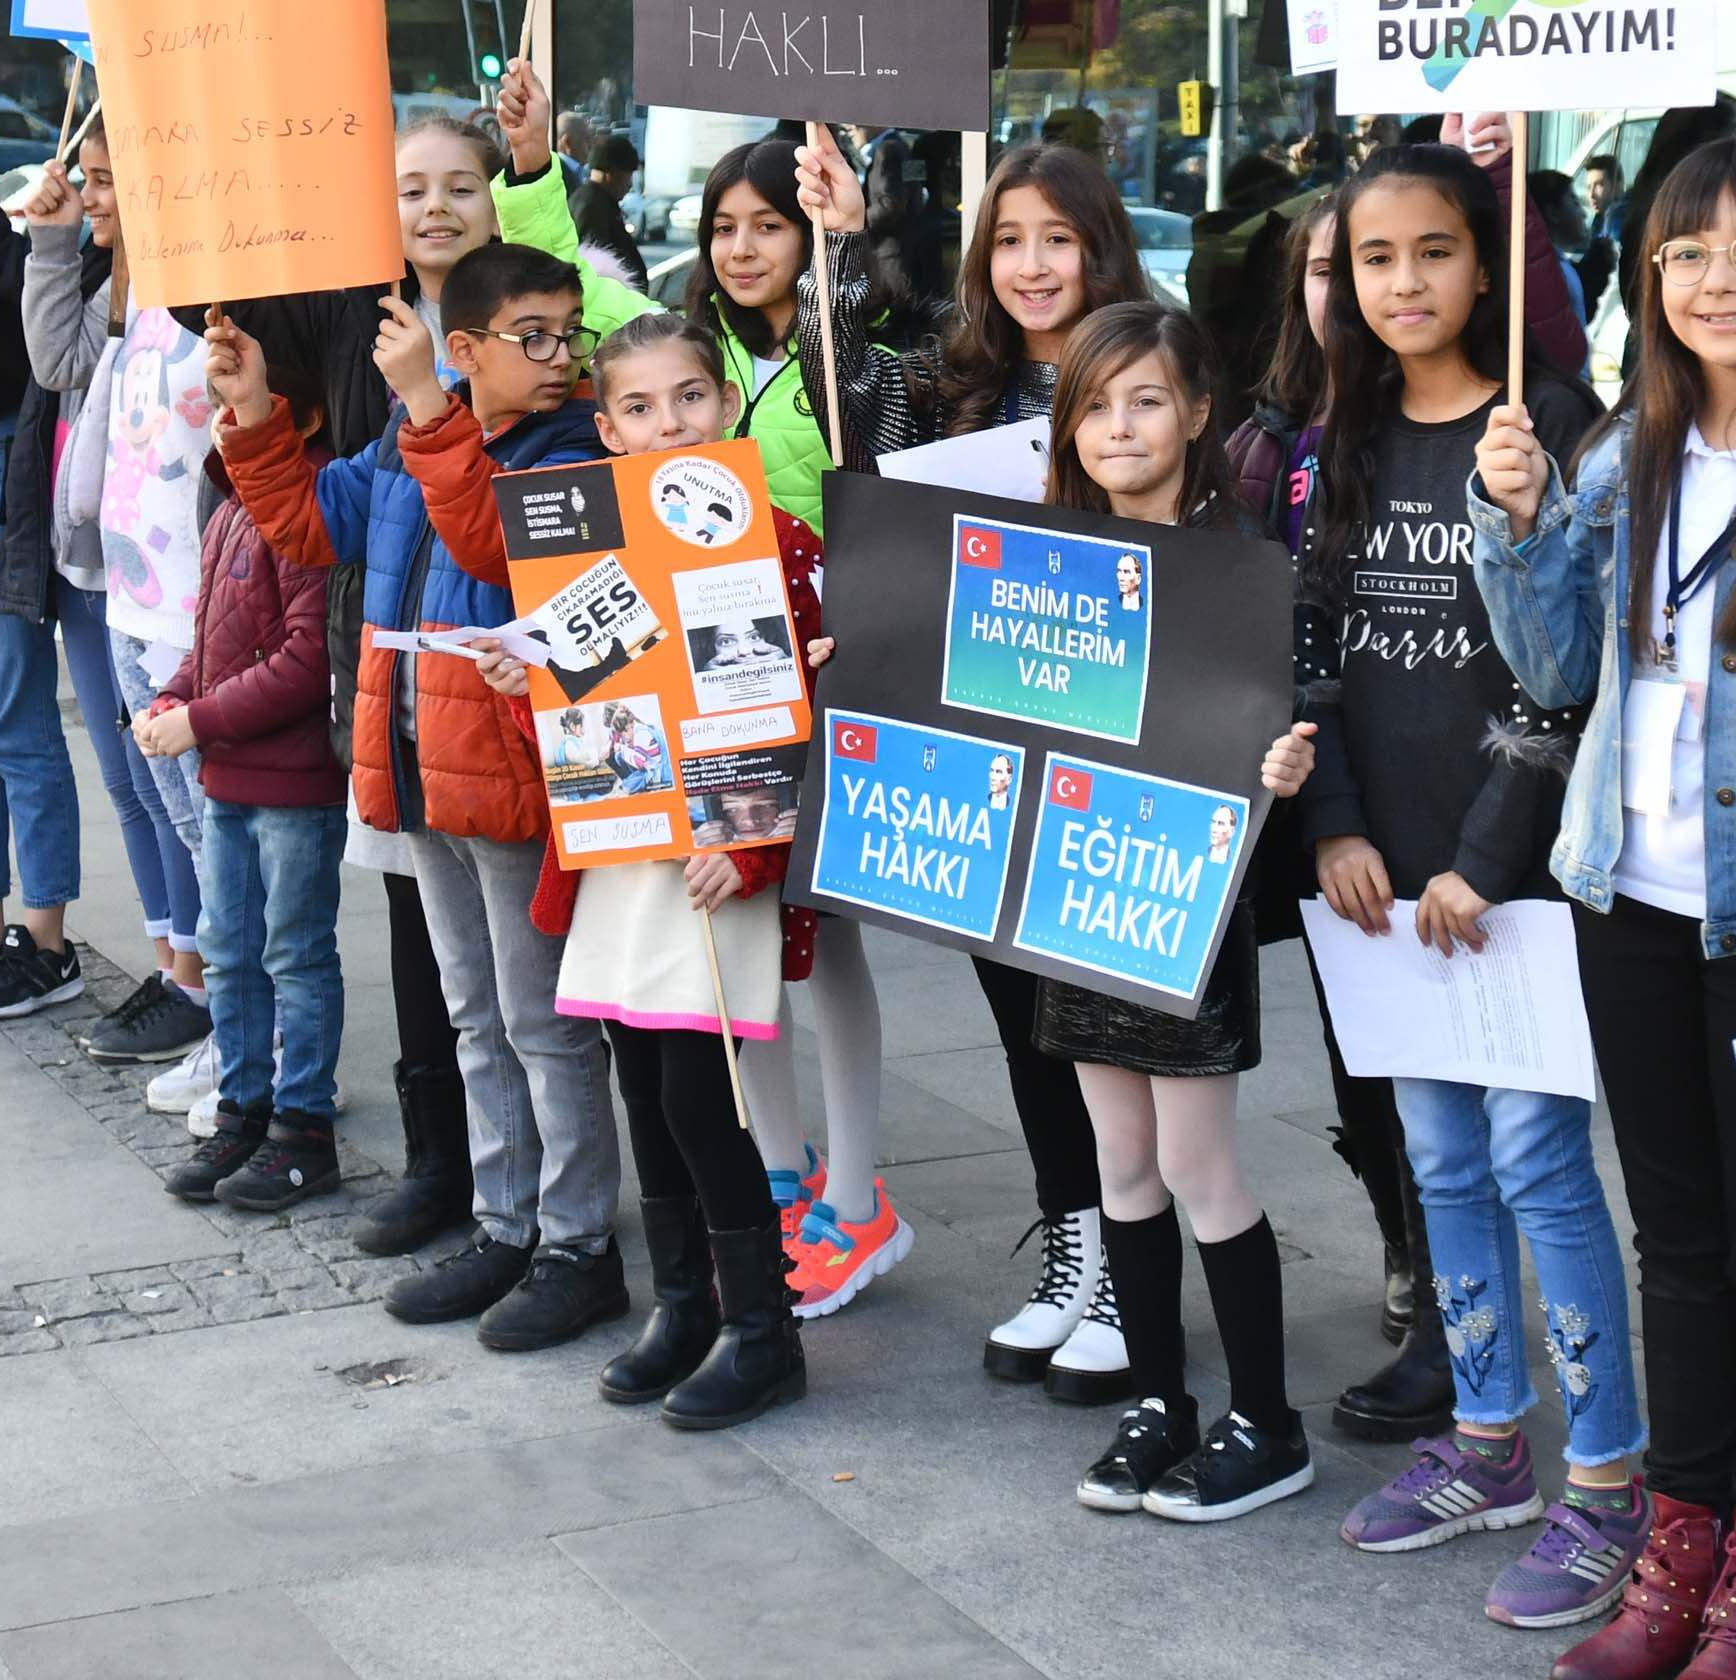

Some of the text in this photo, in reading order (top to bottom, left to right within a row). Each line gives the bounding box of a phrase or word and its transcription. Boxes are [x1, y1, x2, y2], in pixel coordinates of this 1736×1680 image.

[1377, 7, 1676, 61] BURADAYIM!
[231, 106, 365, 144] SESSİZ
[522, 491, 566, 505] ÇOCUK SUSAR
[683, 472, 733, 505] UNUTMA
[1389, 500, 1433, 514] TOKYO
[524, 506, 539, 516] SEN
[1402, 522, 1474, 565] YOR
[551, 559, 617, 612] BİR ÇOCUĞUN
[557, 568, 624, 622] ÇIKARAMADIĞI
[991, 578, 1109, 628] BENİM DE
[1361, 577, 1451, 594] STOCKHOLM
[566, 580, 637, 645] SES
[1381, 605, 1427, 616] LONDON
[970, 611, 1126, 669] HAYALLERİM
[1018, 656, 1071, 696] VAR
[682, 716, 778, 739] BANA DOKUNMA
[570, 817, 665, 848] SEN SUSMA
[841, 773, 992, 850] YAŞAMA
[859, 832, 970, 900] HAKKI
[1058, 815, 1204, 903] EĞİTİM
[1059, 880, 1188, 958] HAKKI
